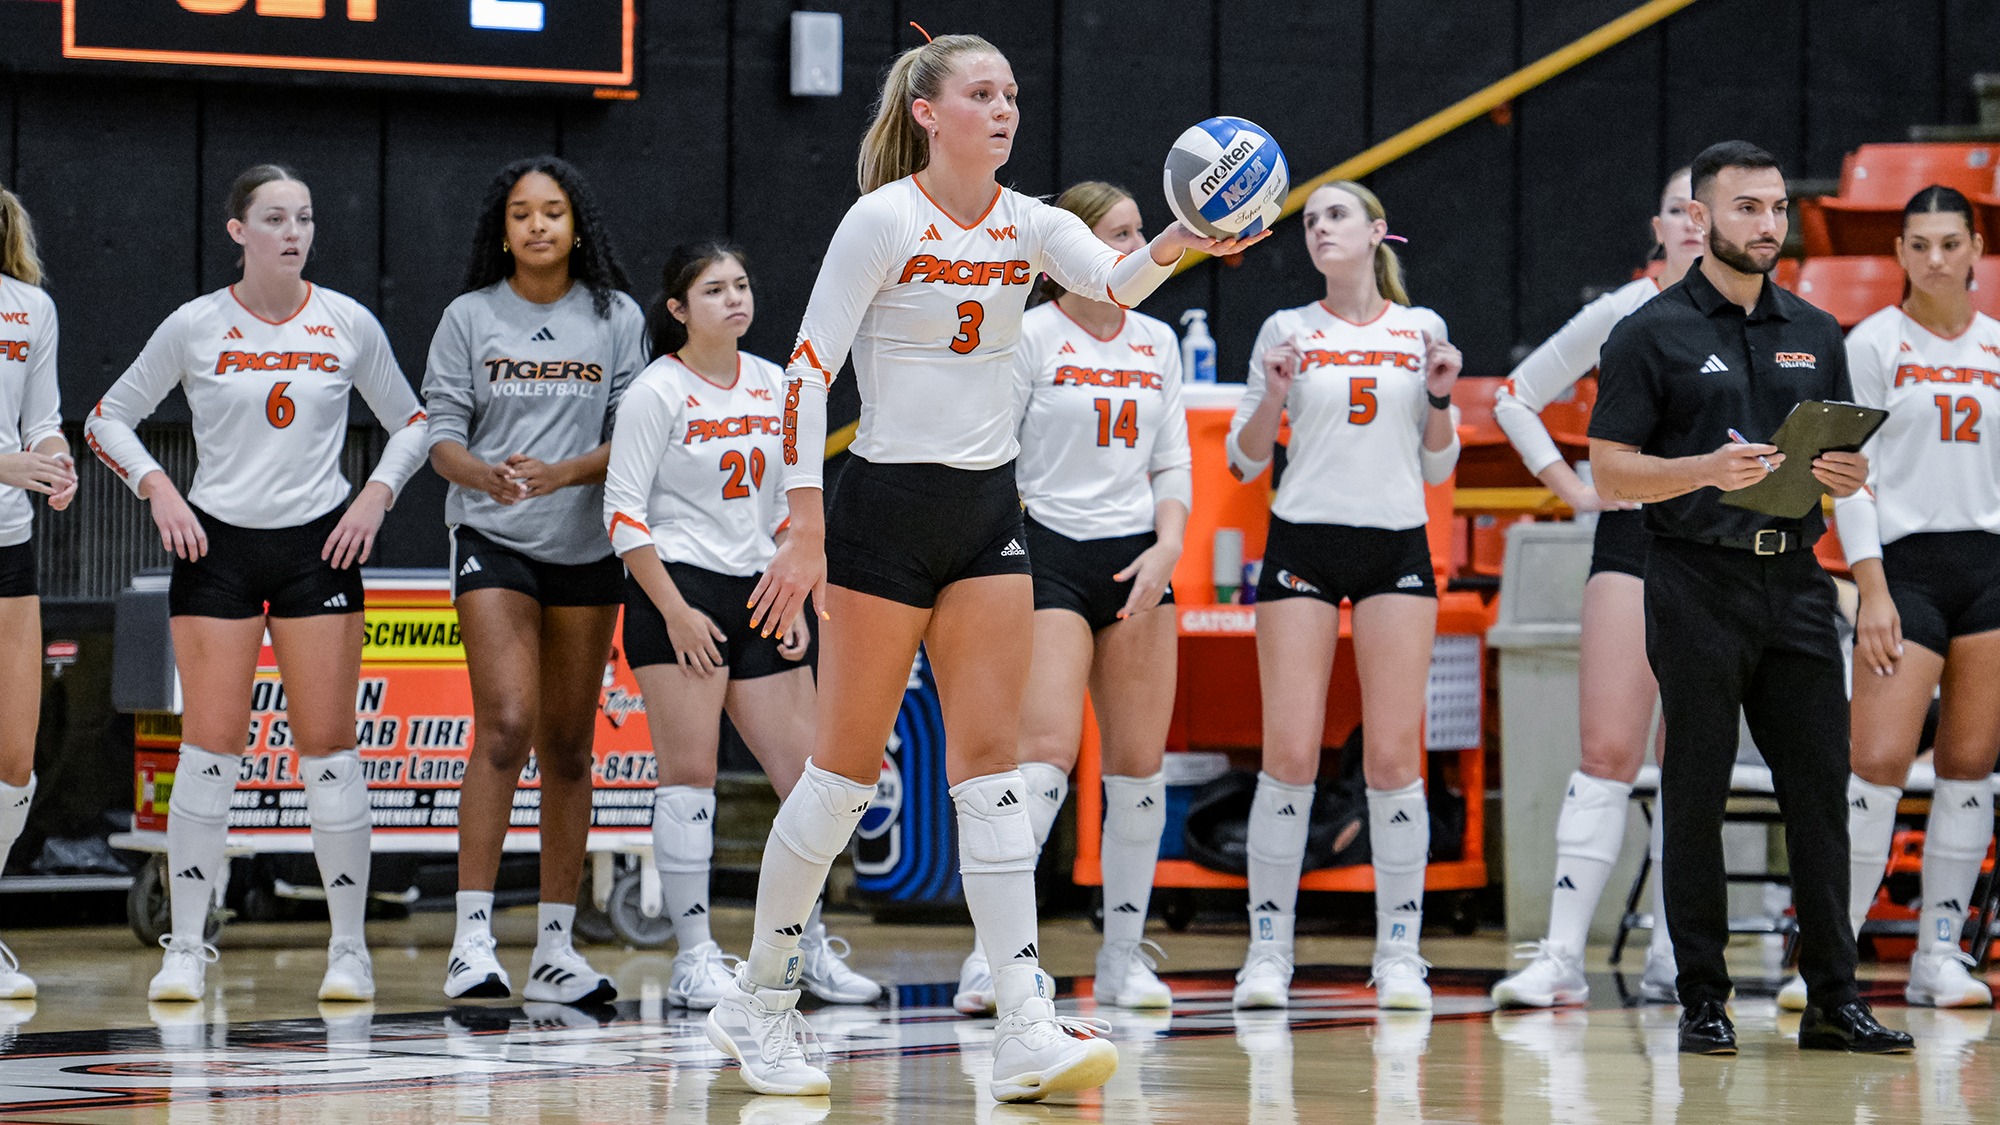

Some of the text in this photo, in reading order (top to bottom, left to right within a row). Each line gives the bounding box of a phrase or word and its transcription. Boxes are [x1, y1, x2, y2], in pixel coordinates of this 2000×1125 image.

[1200, 140, 1254, 196] molten
[897, 254, 1030, 286] PACIFIC
[304, 325, 336, 339] WCC
[948, 300, 985, 355] 3
[215, 351, 340, 375] PACIFIC
[485, 358, 603, 383] TIGERS
[1299, 349, 1421, 373] PACIFIC
[491, 382, 595, 399] VOLLEYBALL
[1052, 365, 1163, 390] PACIFIC
[265, 381, 296, 429] 6
[1348, 377, 1378, 425] 5
[683, 415, 781, 444] PACIFIC
[1094, 398, 1138, 448] 14
[1934, 395, 1982, 443] 12
[720, 447, 766, 500] 20
[363, 622, 462, 646] SCHWAB
[408, 719, 469, 747] TIRE
[409, 755, 464, 782] Lane
